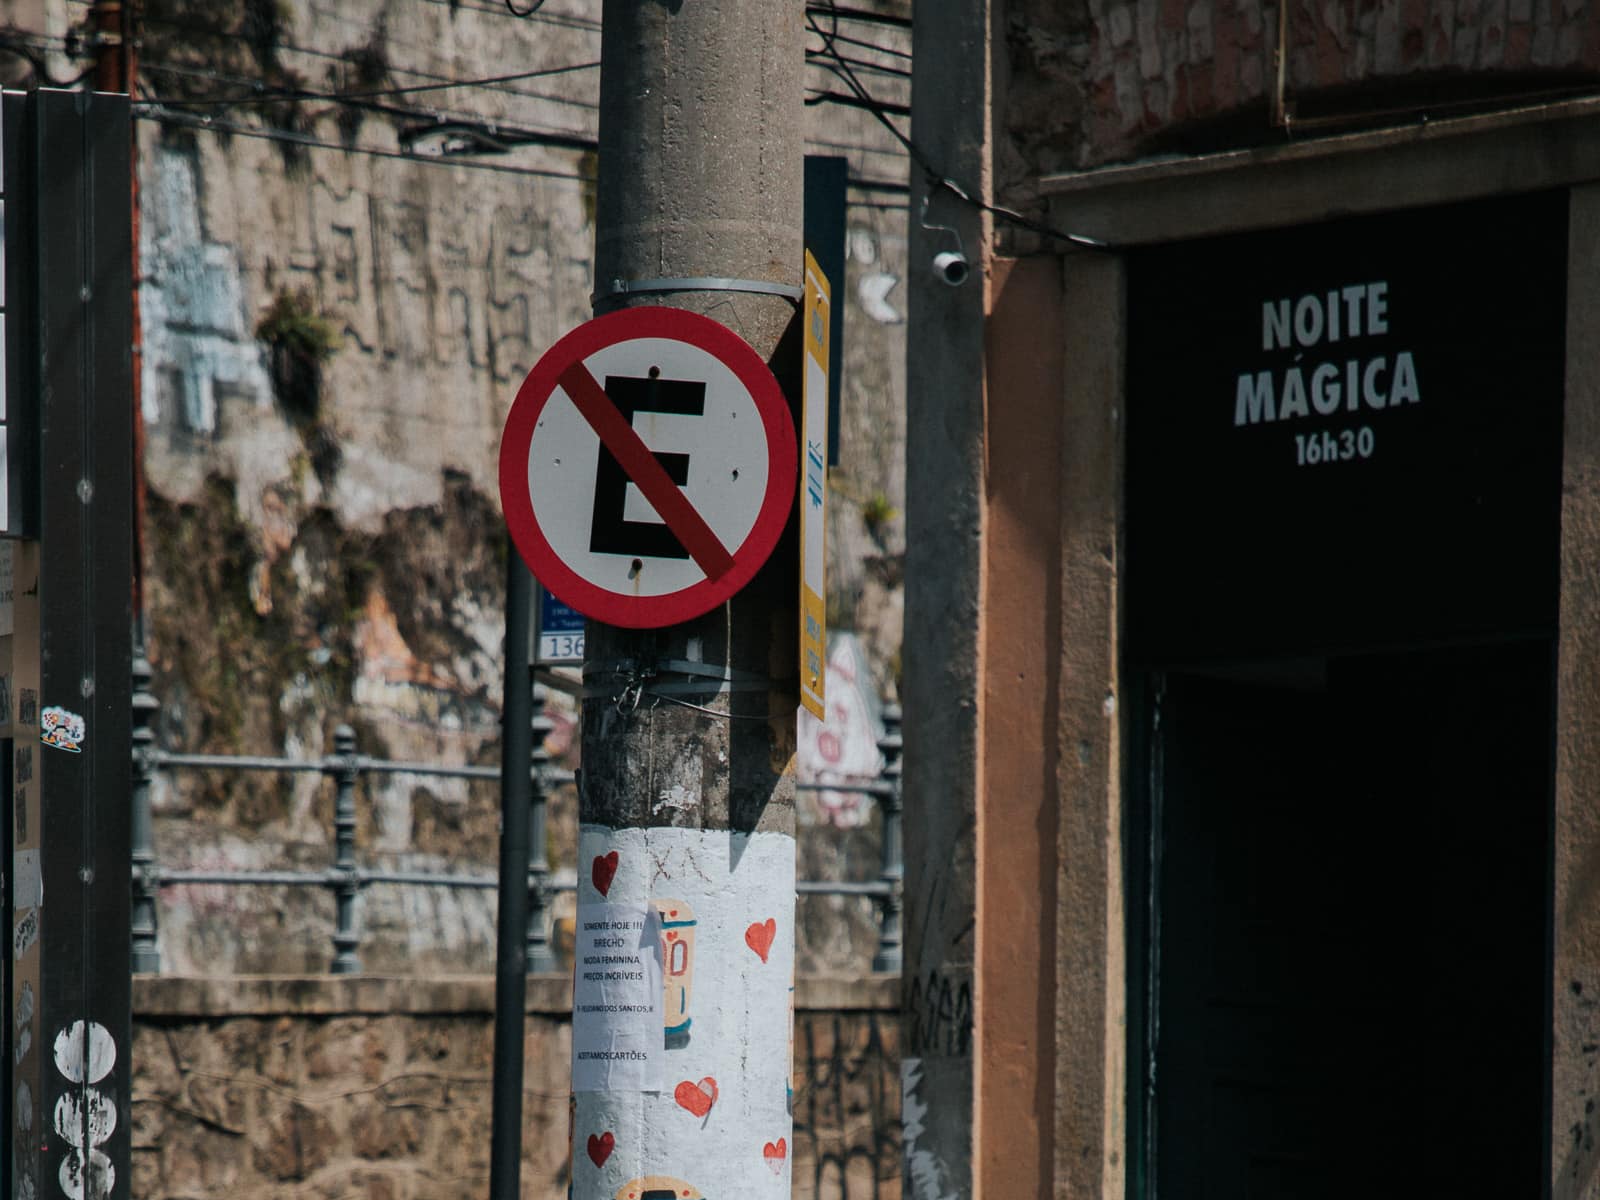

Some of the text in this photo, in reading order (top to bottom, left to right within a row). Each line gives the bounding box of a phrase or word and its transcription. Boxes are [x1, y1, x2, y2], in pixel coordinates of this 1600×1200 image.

[1262, 281, 1388, 351] NOITE
[1234, 351, 1421, 427] MÁGICA
[1295, 426, 1375, 467] 16h30
[589, 375, 706, 560] E
[611, 921, 631, 930] HOJE
[602, 955, 640, 965] FEMININA
[605, 970, 644, 981] INCRÍVEIS
[609, 1050, 647, 1061] CARTÕES
